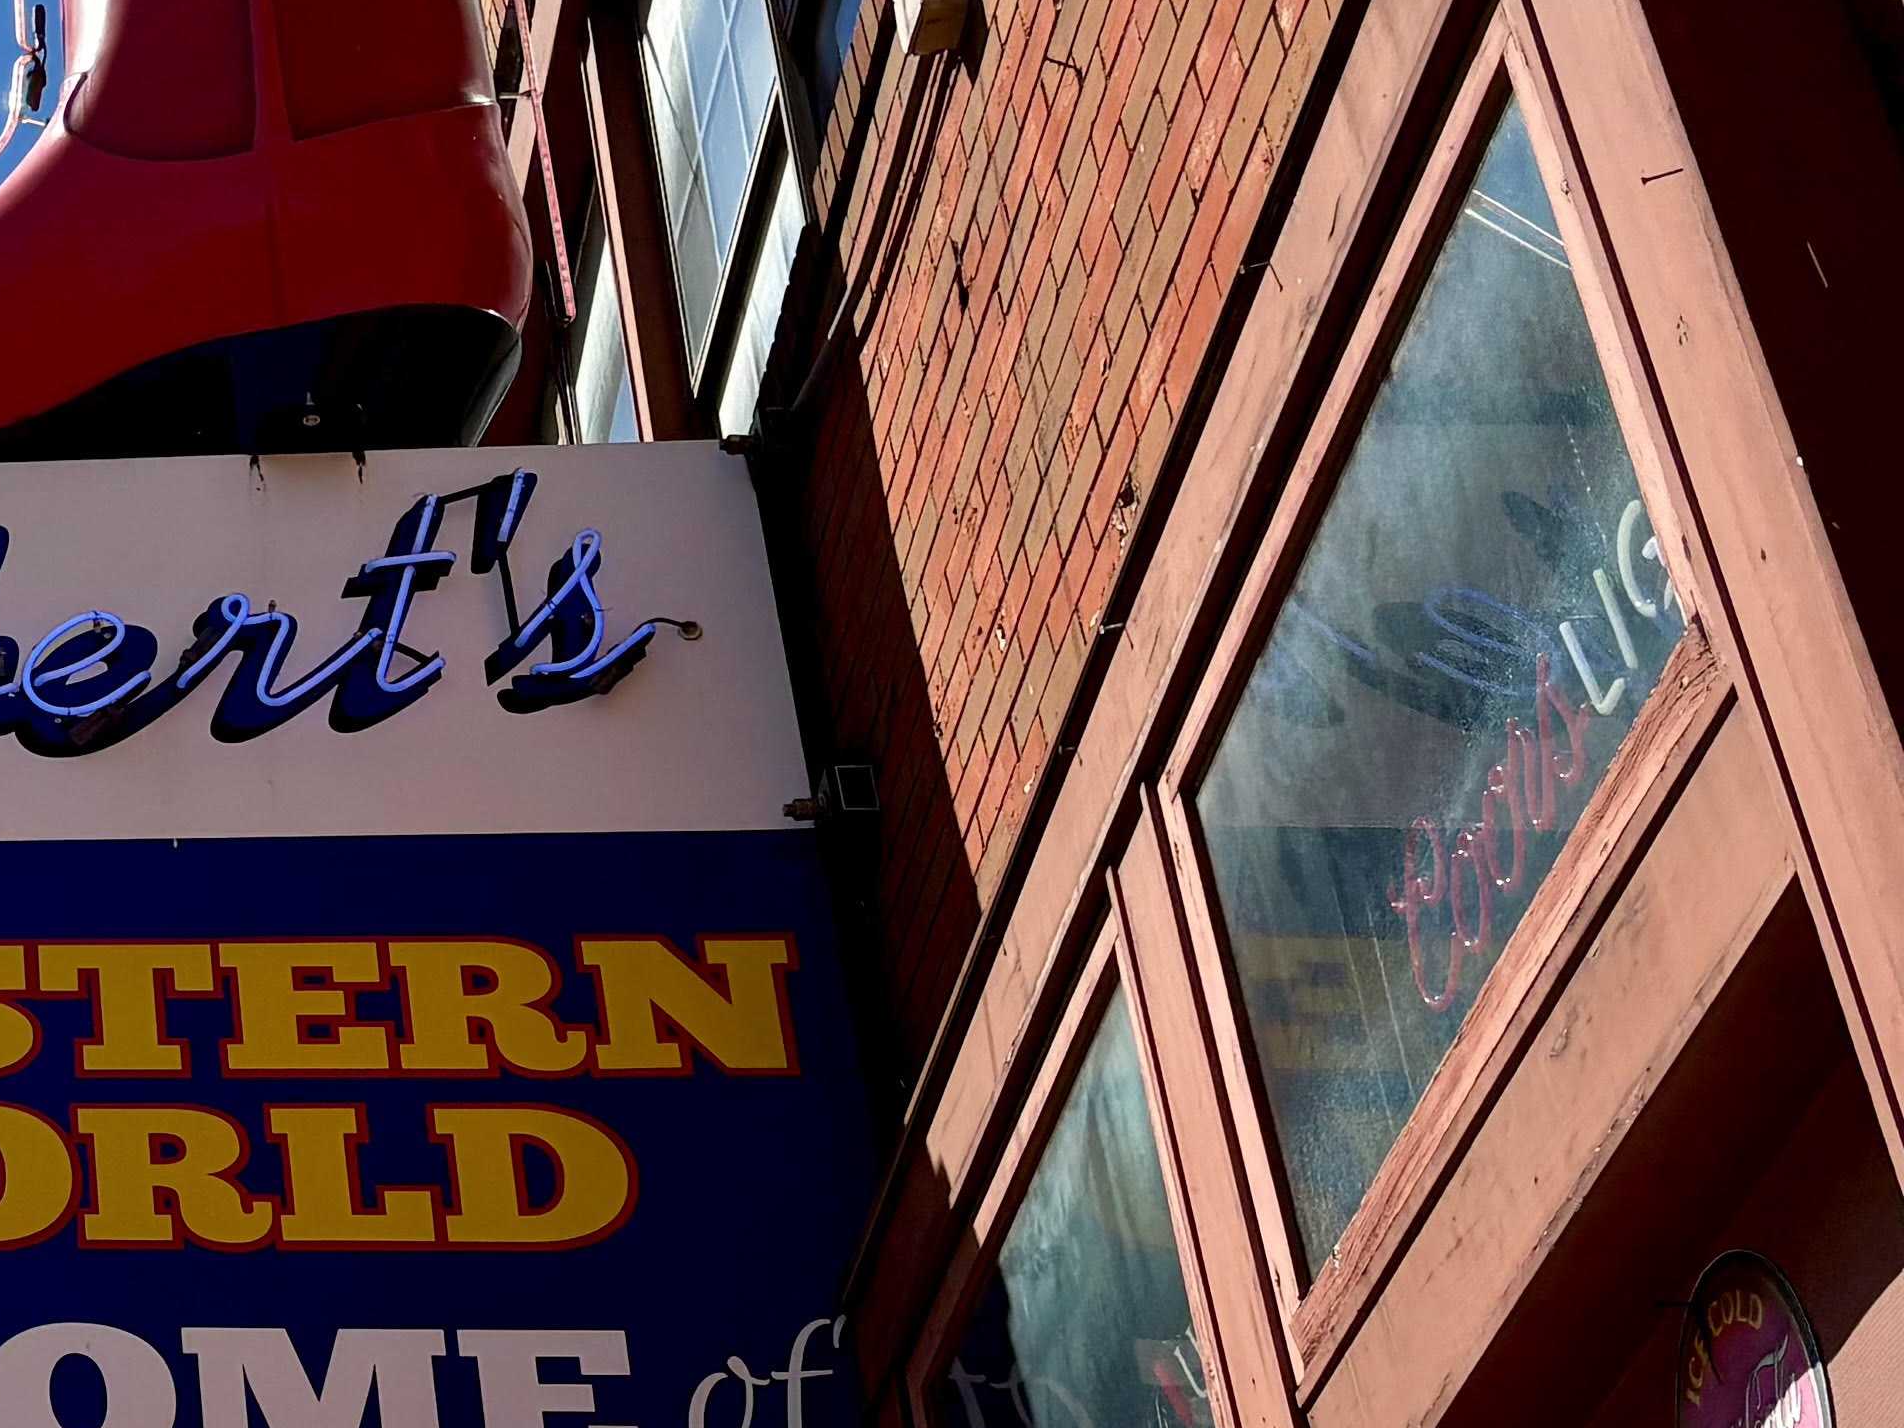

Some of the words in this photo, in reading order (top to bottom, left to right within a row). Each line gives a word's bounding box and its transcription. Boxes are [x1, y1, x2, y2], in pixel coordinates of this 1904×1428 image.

[1559, 499, 1684, 715] LIG
[1387, 652, 1590, 1012] Coors
[1708, 1288, 1763, 1338] COLD
